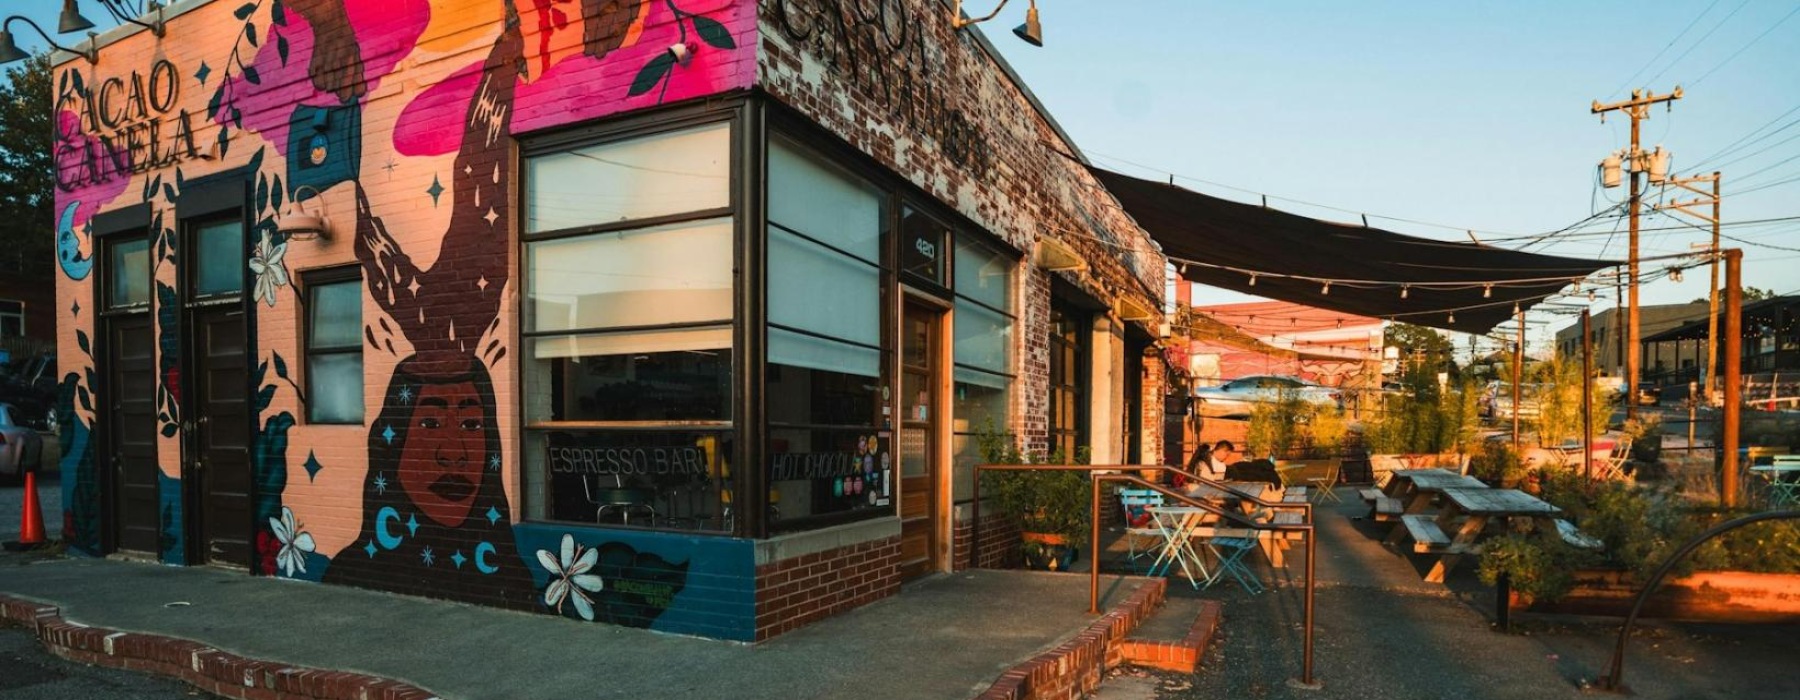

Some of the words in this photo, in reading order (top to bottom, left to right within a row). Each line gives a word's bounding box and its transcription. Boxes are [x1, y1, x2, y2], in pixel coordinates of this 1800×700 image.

[55, 59, 178, 144] CACAO
[56, 108, 200, 192] CANELA
[916, 237, 935, 259] 420
[550, 447, 649, 475] ESPRESSO
[771, 452, 800, 480] HOT
